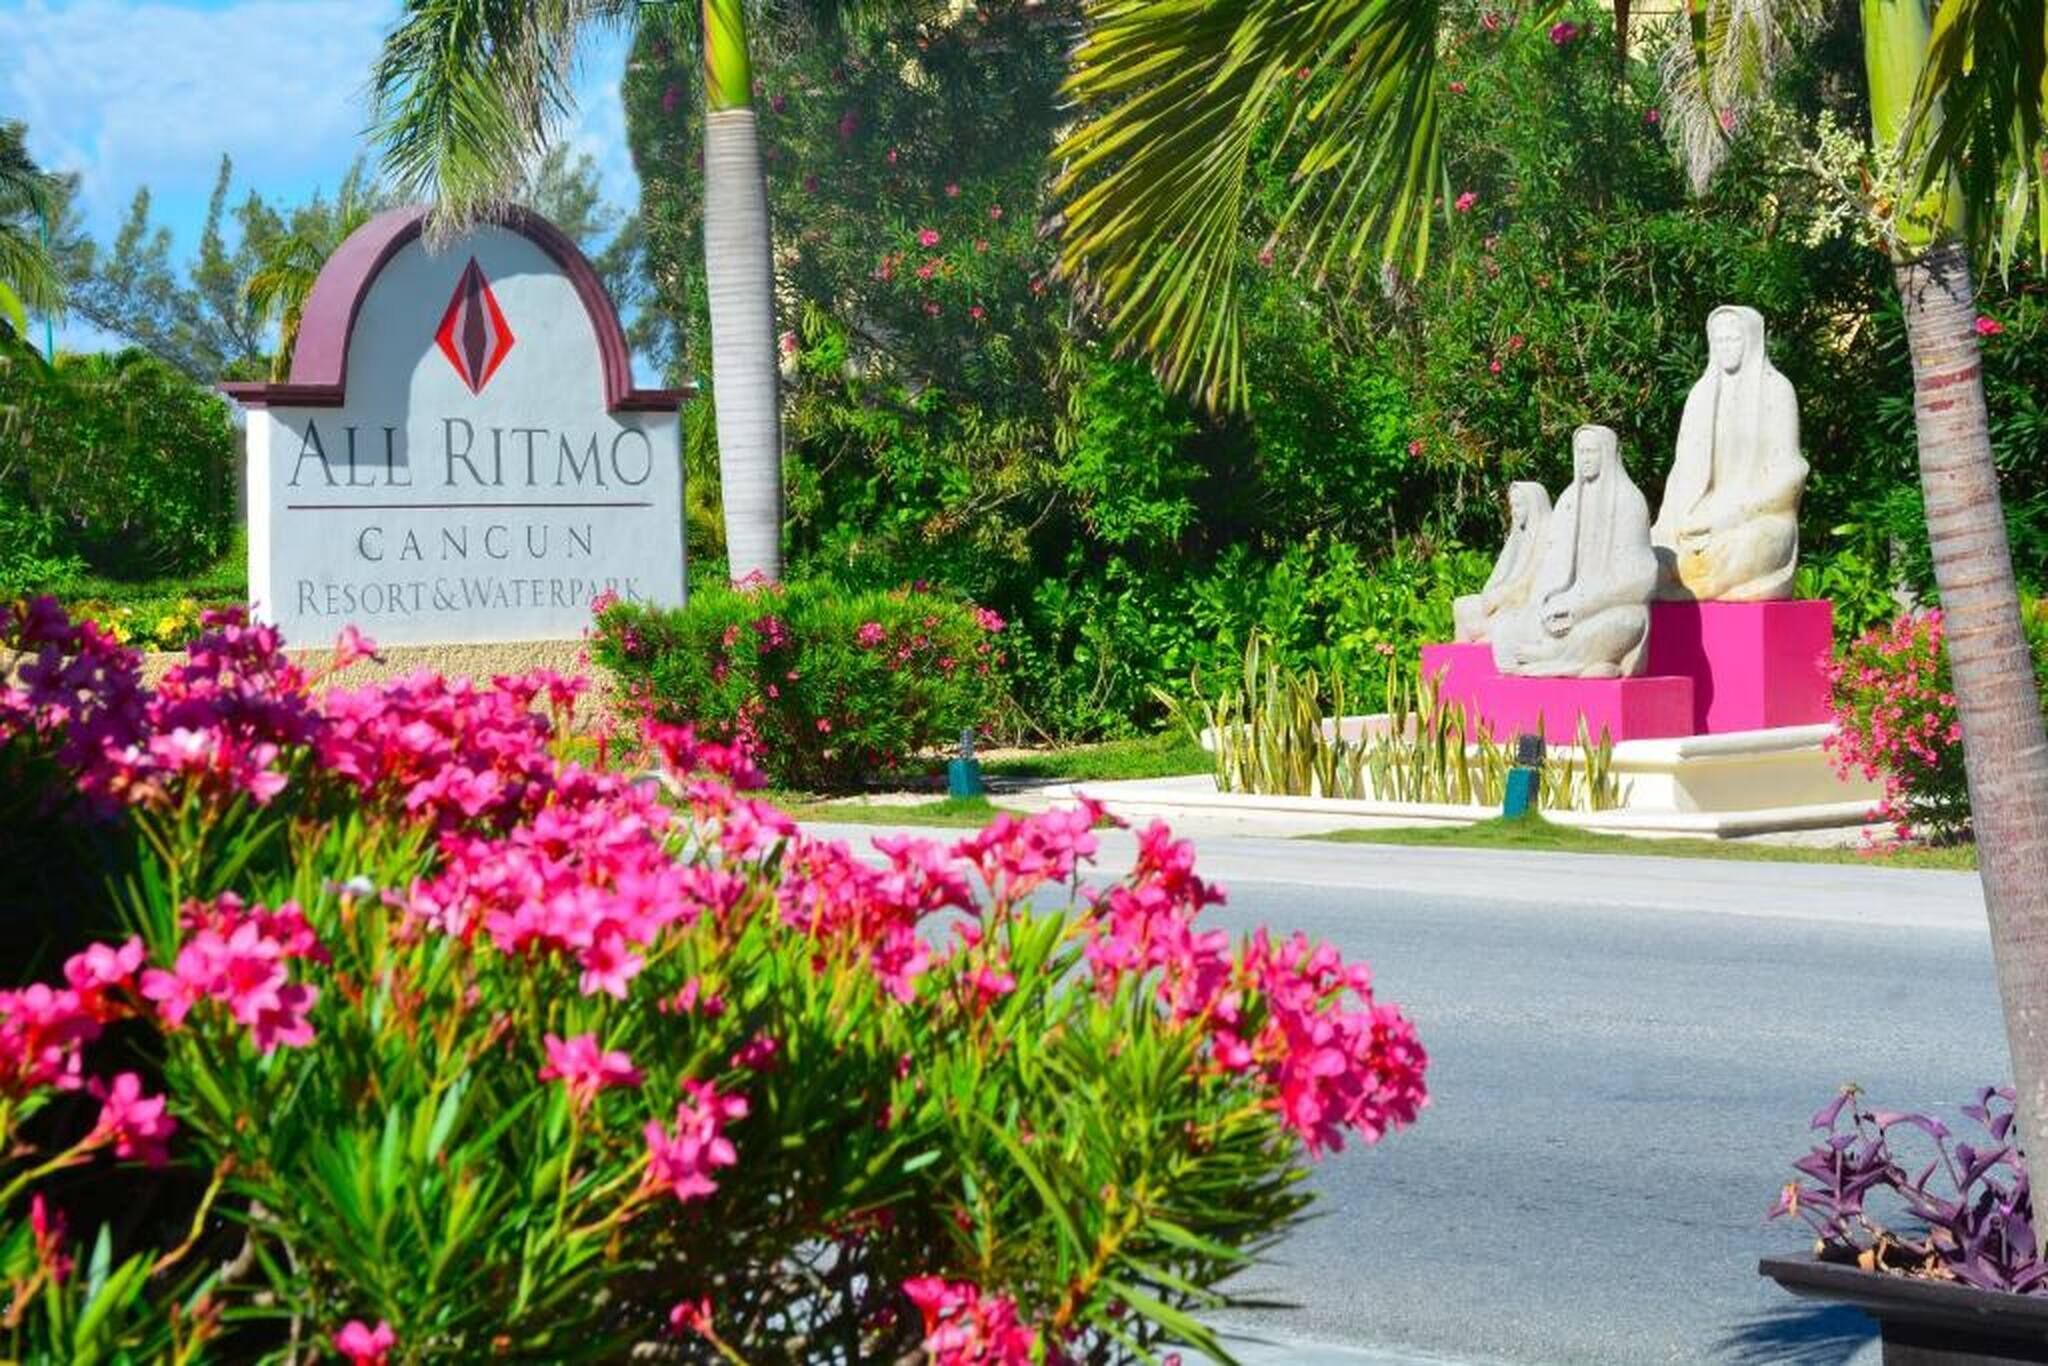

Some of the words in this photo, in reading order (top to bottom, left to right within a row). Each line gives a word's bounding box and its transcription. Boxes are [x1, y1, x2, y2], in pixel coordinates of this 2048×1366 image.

[287, 417, 413, 488] ALL
[441, 417, 654, 489] RITMO
[357, 524, 593, 562] CANCUN
